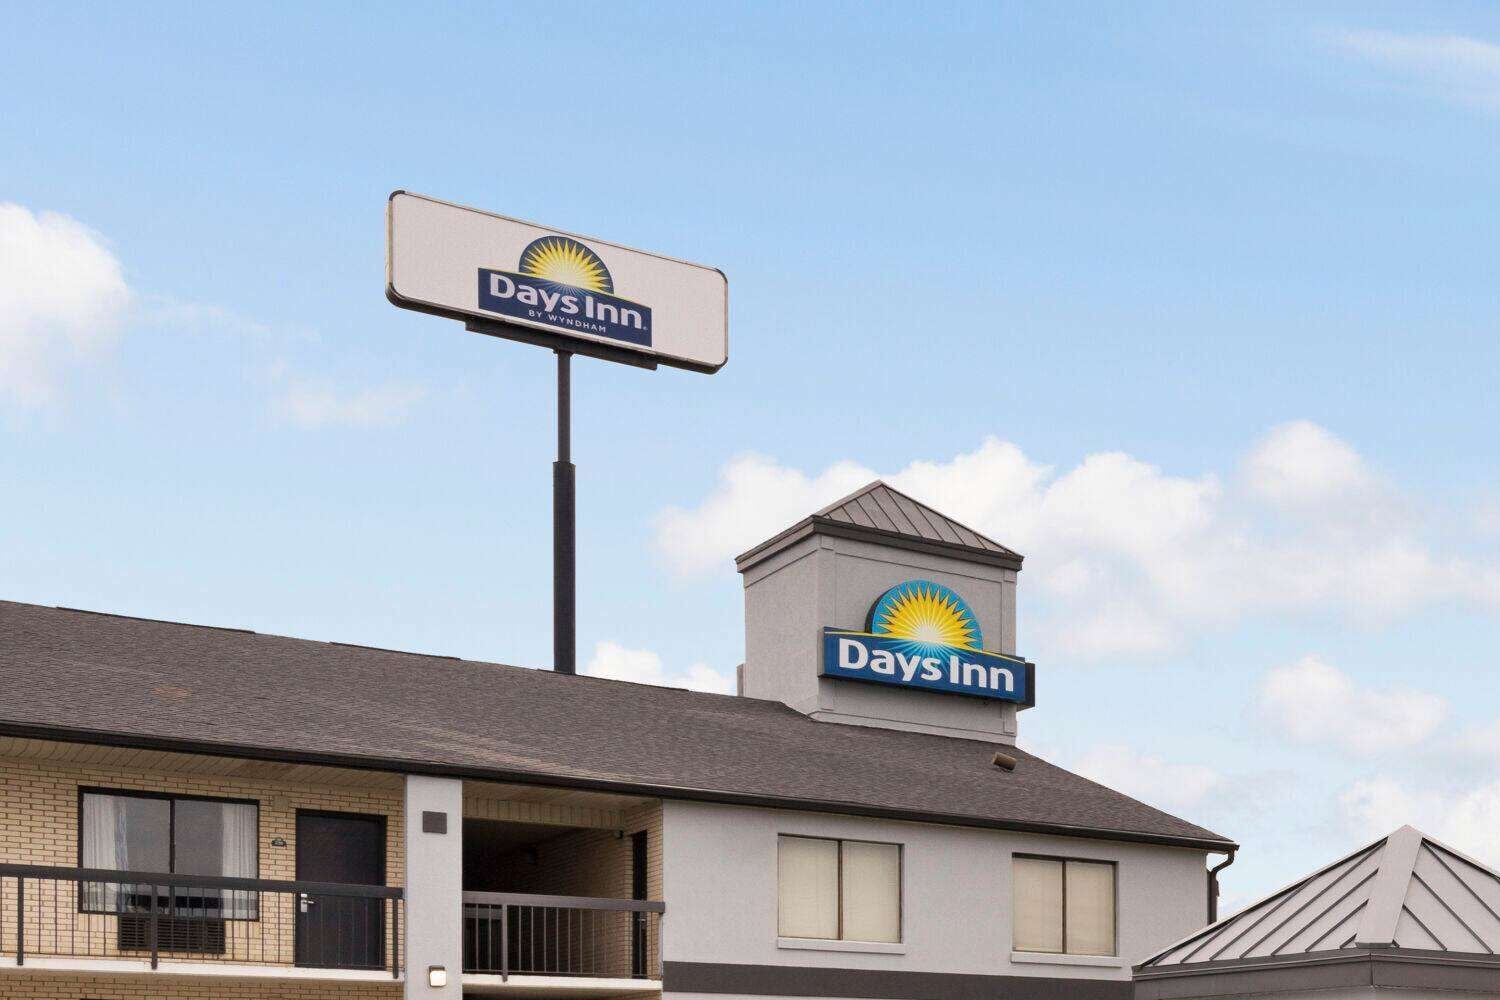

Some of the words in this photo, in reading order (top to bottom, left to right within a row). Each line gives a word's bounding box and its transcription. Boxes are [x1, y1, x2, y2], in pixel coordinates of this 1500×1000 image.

[489, 273, 579, 314] Days
[585, 295, 642, 330] Inn
[528, 309, 542, 318] BY
[548, 314, 606, 333] WYNDHAM
[838, 638, 942, 682] Days
[949, 655, 1014, 692] Inn
